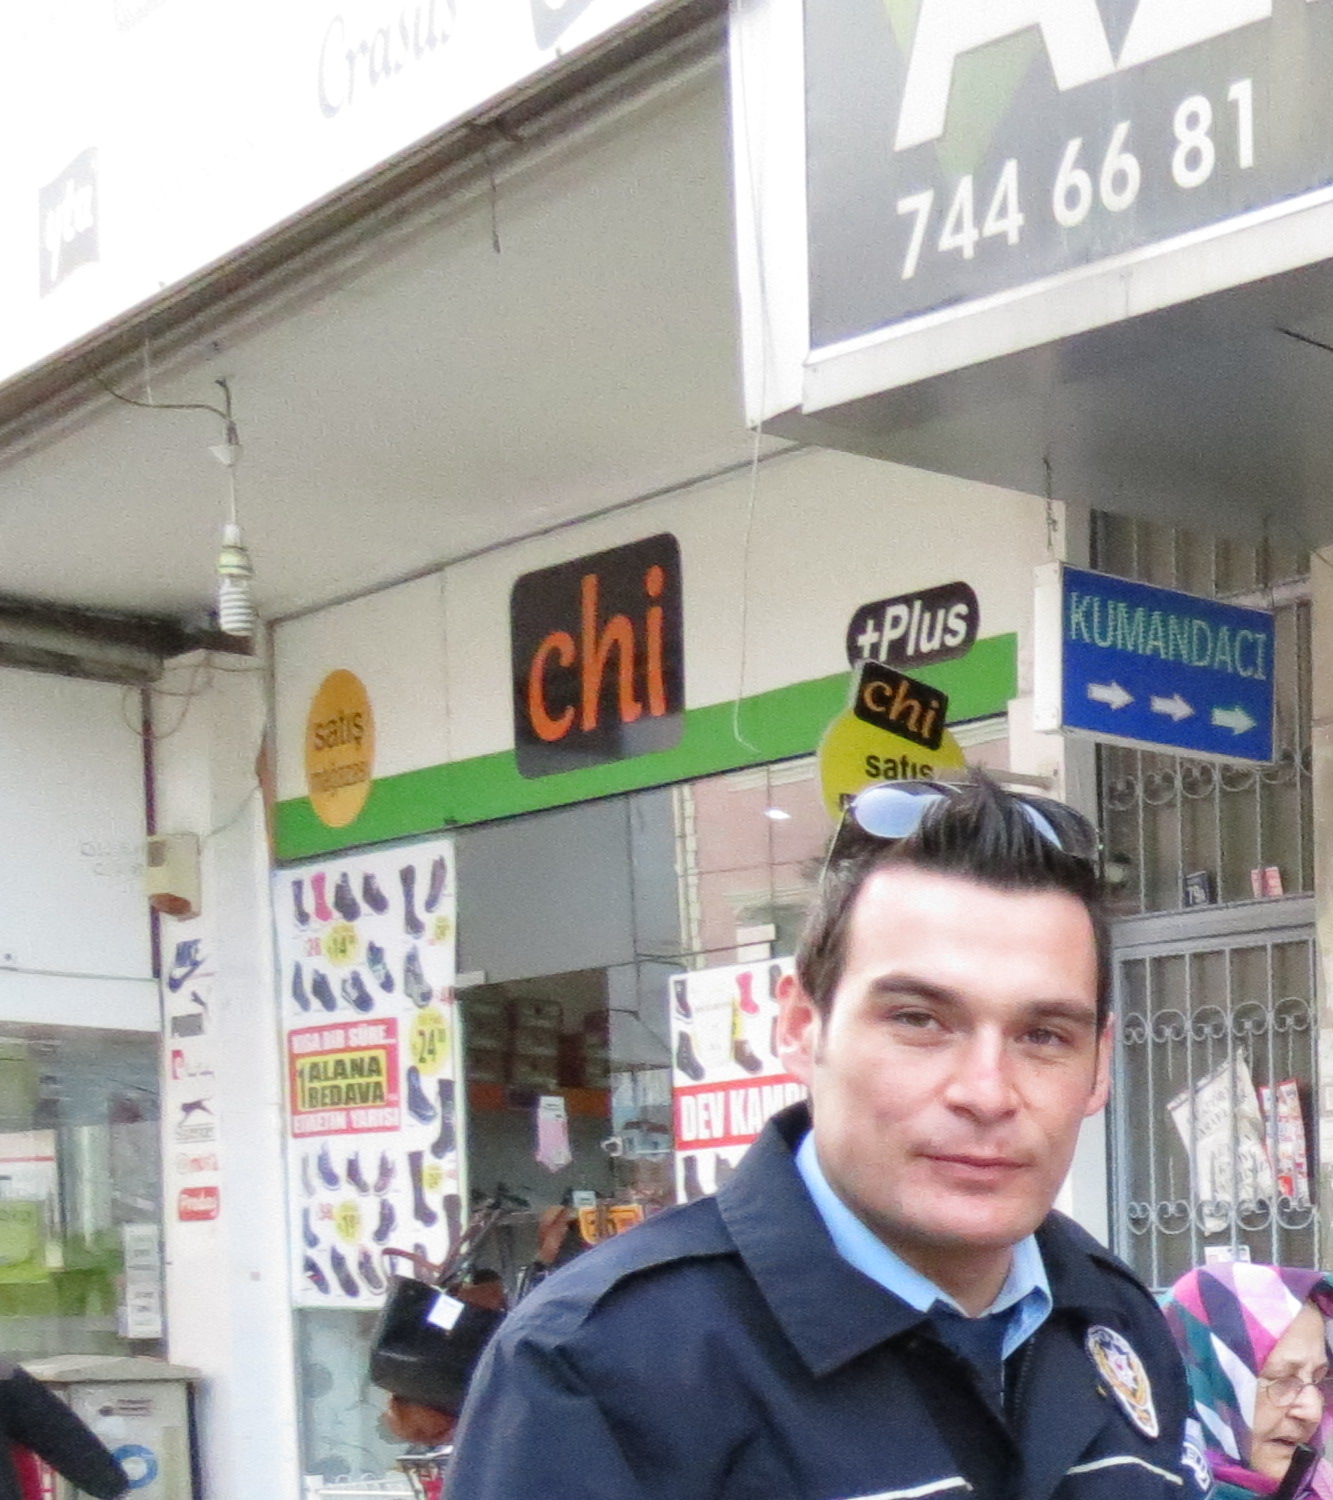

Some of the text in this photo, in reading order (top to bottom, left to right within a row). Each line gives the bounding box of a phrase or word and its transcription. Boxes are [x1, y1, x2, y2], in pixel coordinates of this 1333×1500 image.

[897, 78, 1254, 280] 744 66 81
[527, 565, 669, 742] chi
[1068, 591, 1267, 681] KUMANDACI
[863, 680, 940, 739] chi
[307, 1081, 386, 1109] BEDAVA
[308, 1056, 382, 1084] ALANA
[680, 1090, 725, 1142] DEV
